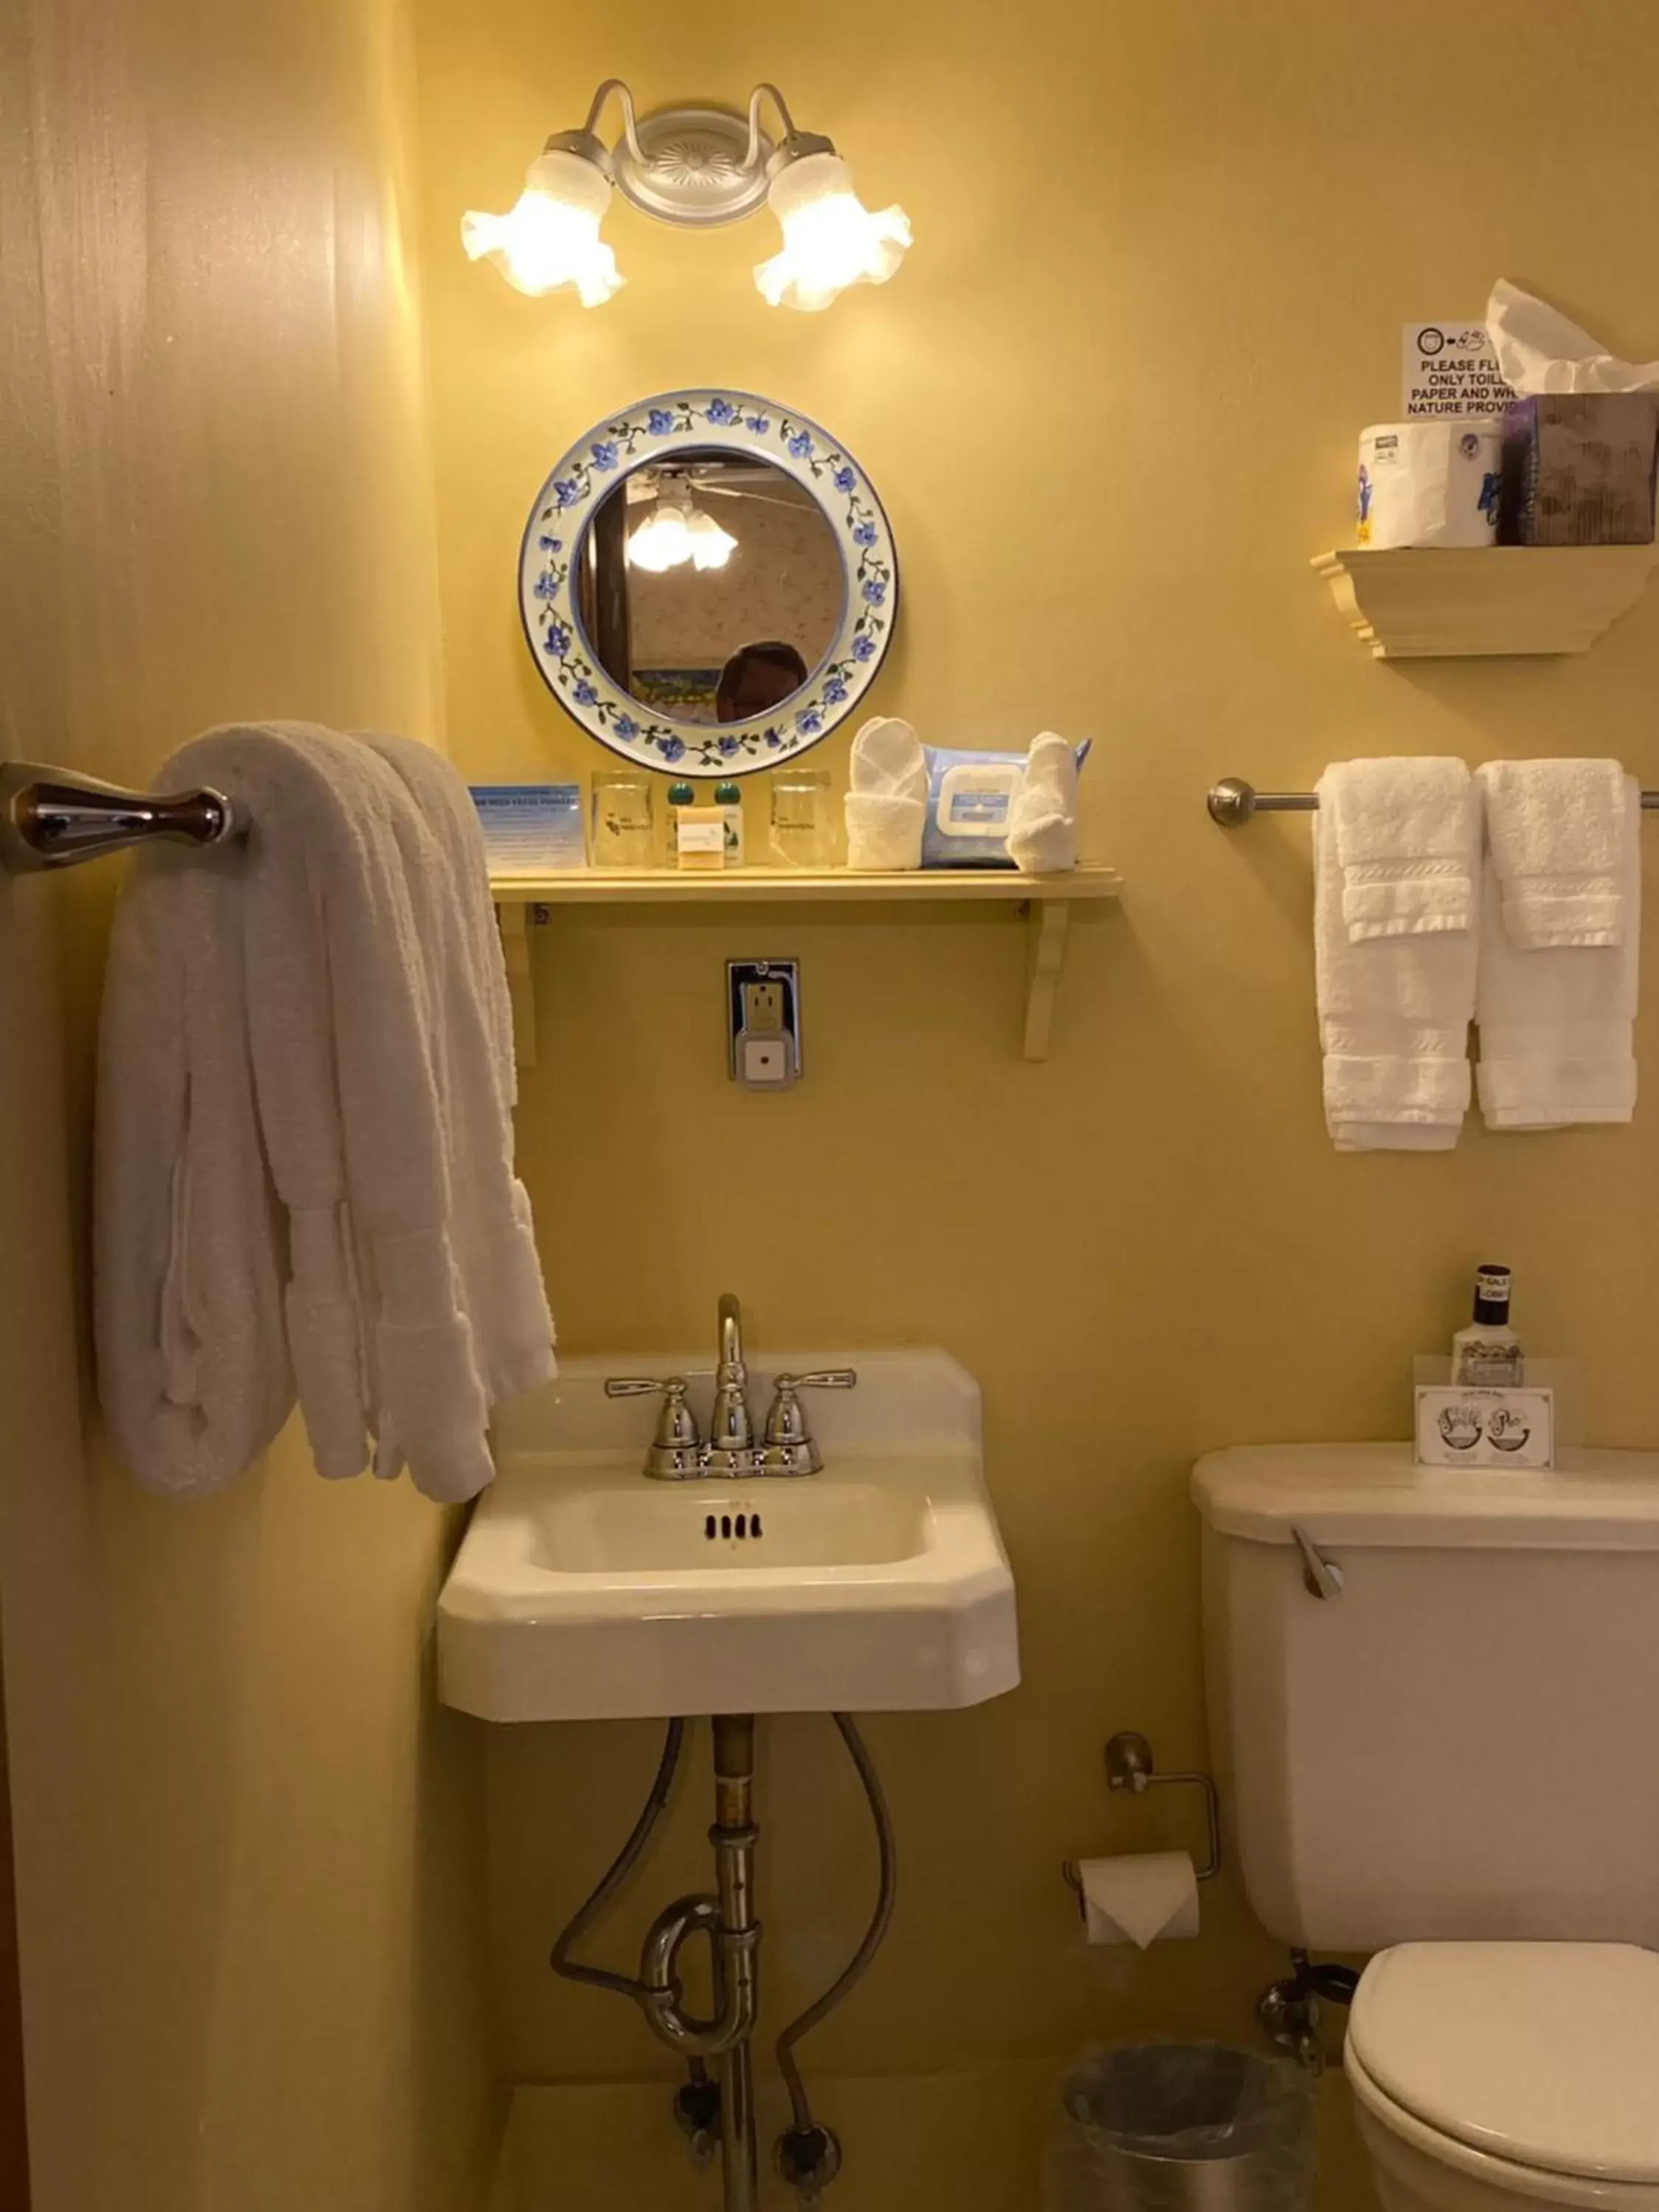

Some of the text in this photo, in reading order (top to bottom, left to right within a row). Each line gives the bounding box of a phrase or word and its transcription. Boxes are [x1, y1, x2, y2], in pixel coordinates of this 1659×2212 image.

[1421, 360, 1475, 372] PLEASE
[1428, 374, 1464, 386] ONLY
[1411, 387, 1517, 400] PAPER AND WH
[1408, 403, 1464, 414] NATURE
